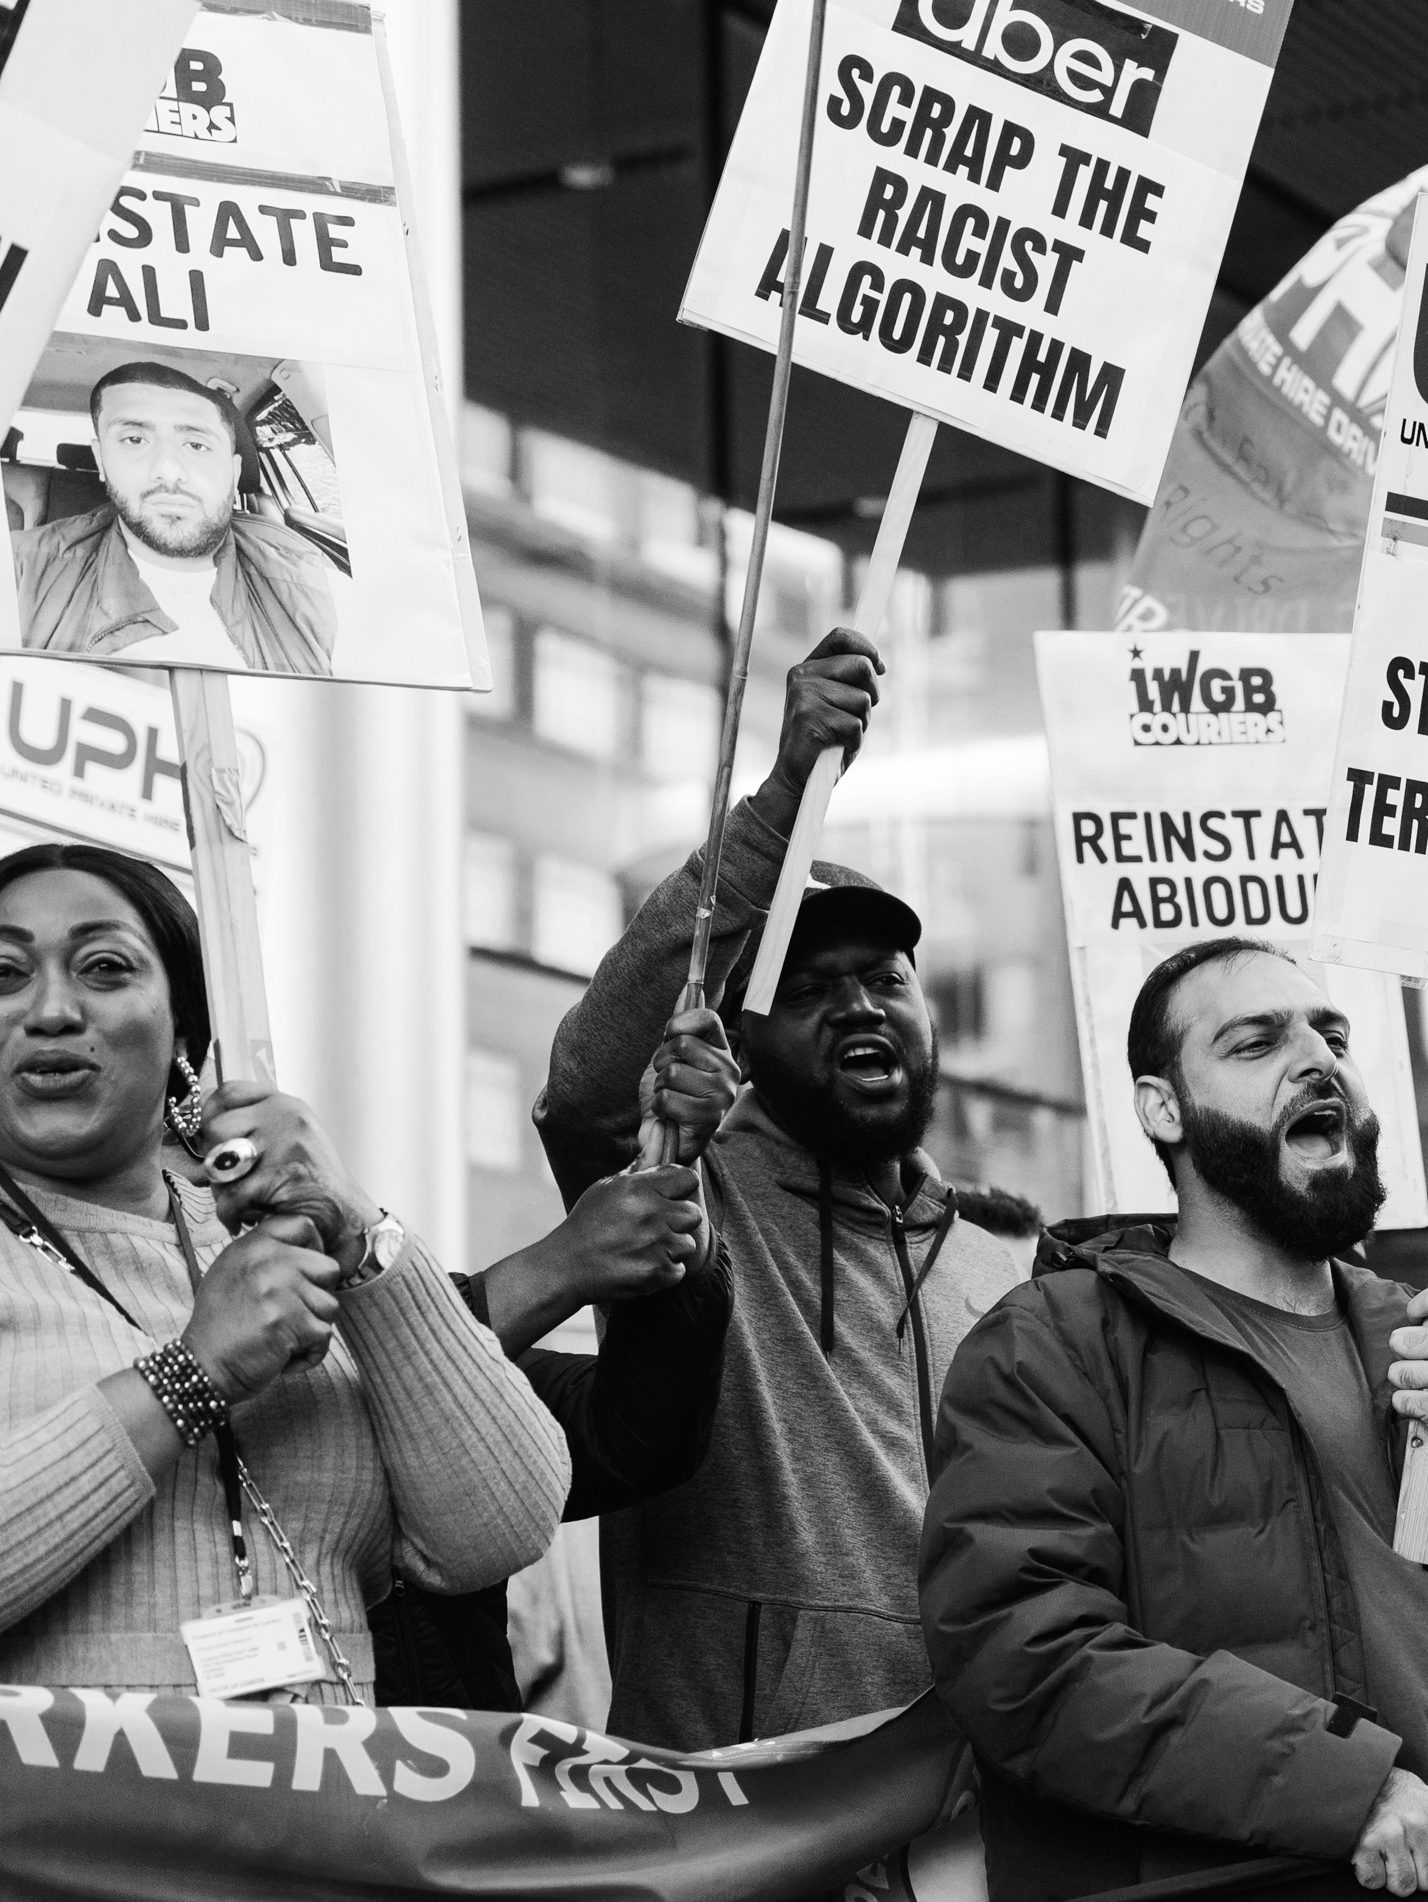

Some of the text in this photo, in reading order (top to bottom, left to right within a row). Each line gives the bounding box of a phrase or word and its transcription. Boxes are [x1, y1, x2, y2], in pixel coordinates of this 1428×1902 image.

[826, 54, 1165, 254] SCRAP THE
[93, 185, 362, 276] STATE
[857, 165, 1085, 317] RACIST
[87, 258, 210, 332] ALI
[754, 228, 1125, 440] ALGORITHM
[1273, 355, 1331, 427] HIRE
[1327, 406, 1378, 476] DRIV
[1130, 711, 1286, 745] COURIERS
[1072, 808, 1327, 865] REINSTAT
[1111, 873, 1317, 930] ABIODU
